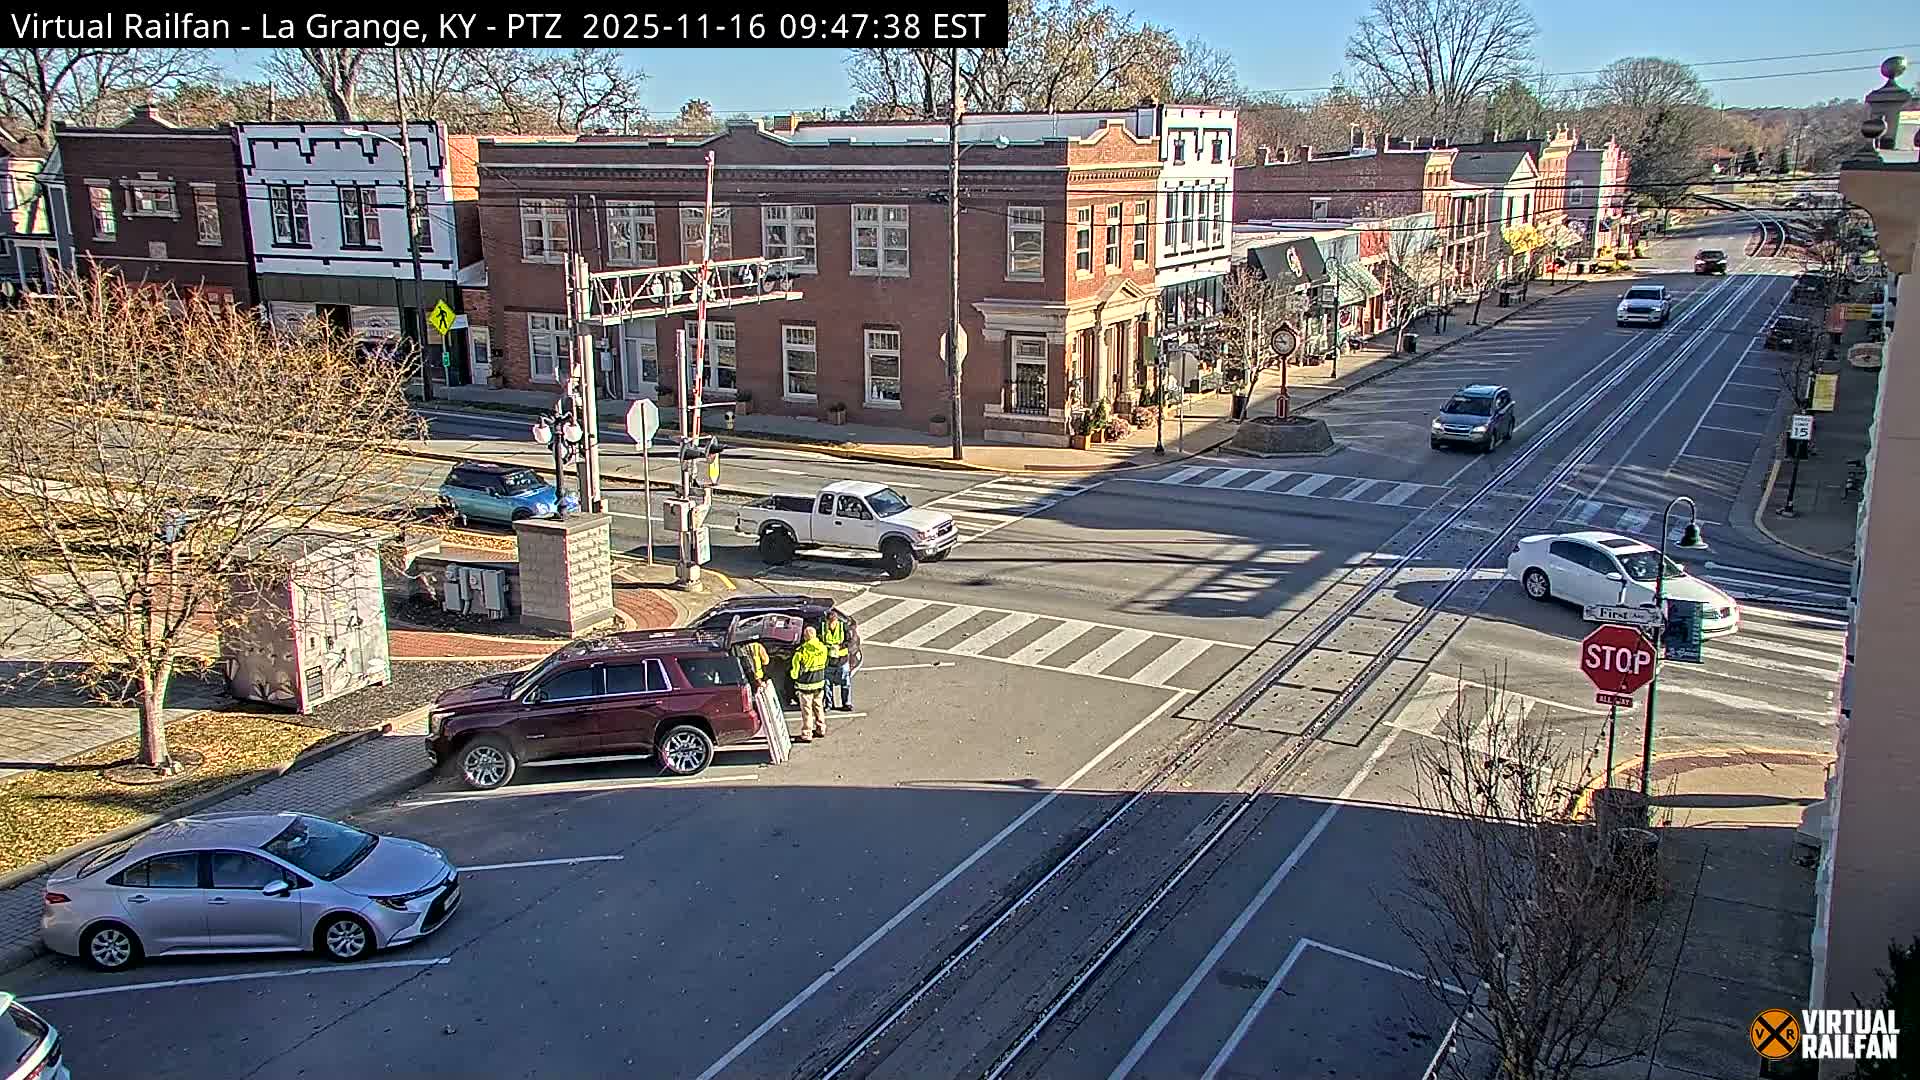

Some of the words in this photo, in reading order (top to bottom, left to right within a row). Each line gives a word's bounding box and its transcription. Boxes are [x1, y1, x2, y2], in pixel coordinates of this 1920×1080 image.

[1794, 428, 1809, 437] 15
[1600, 607, 1628, 620] First
[1585, 643, 1651, 675] STOP
